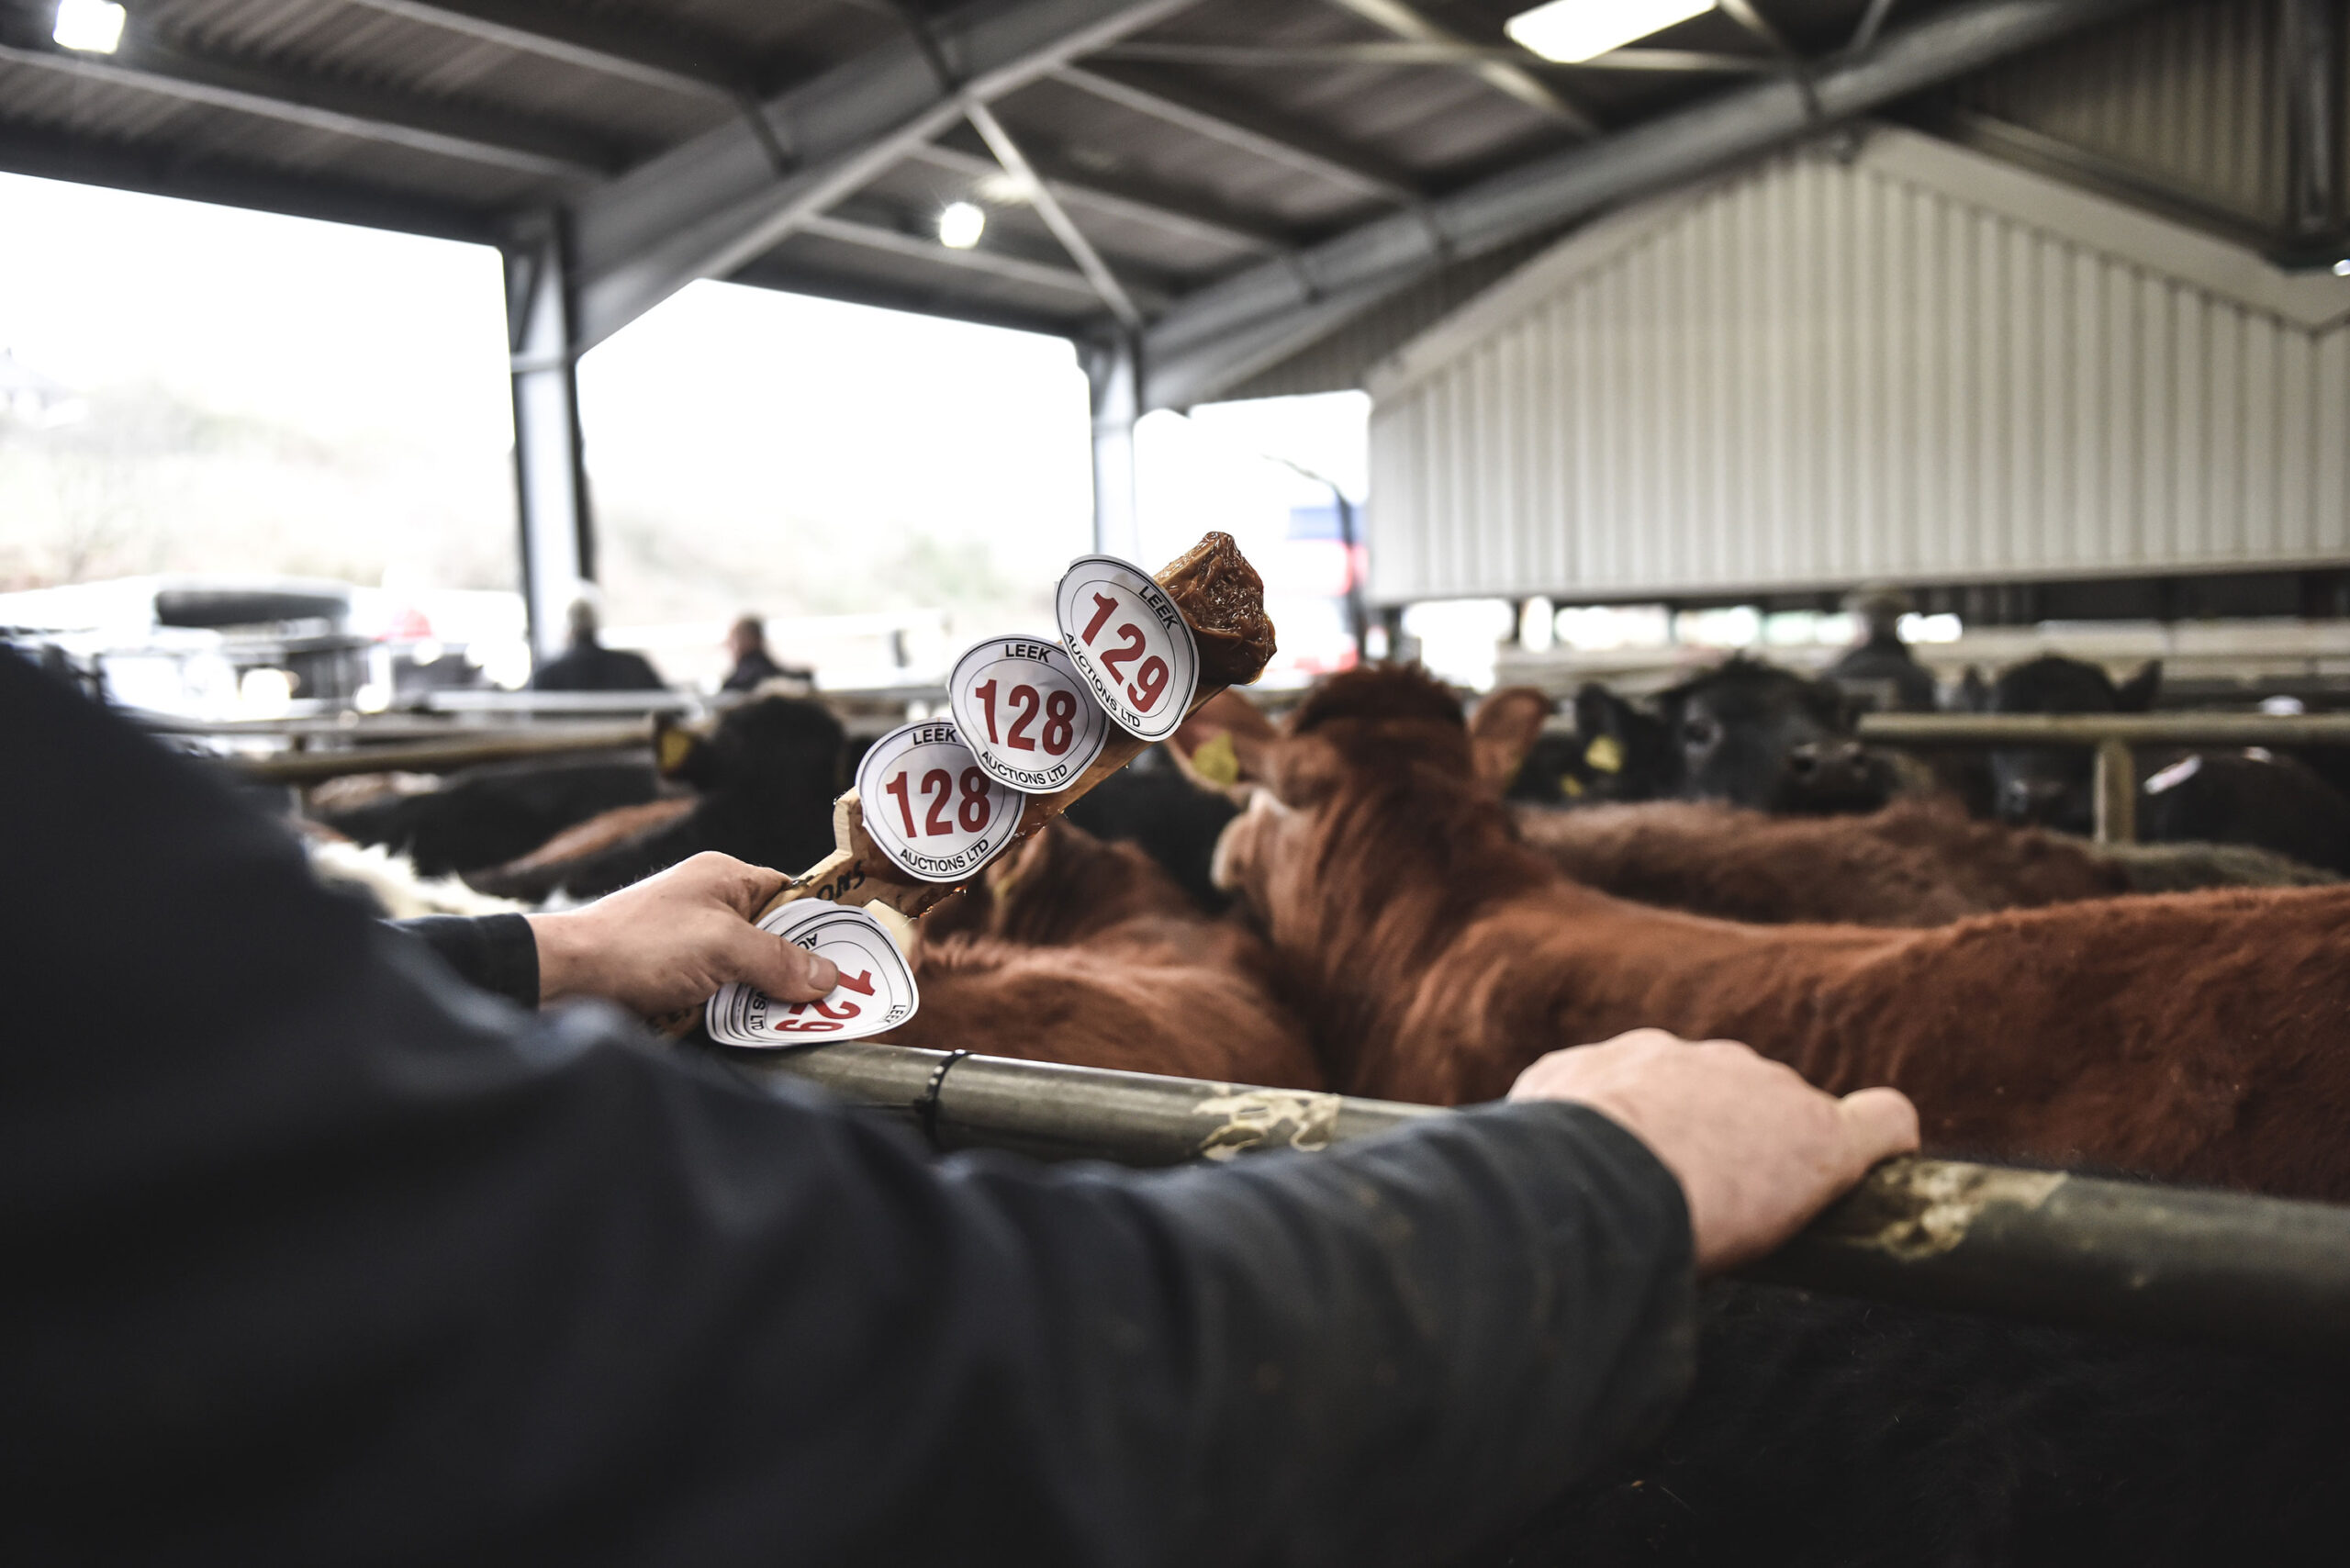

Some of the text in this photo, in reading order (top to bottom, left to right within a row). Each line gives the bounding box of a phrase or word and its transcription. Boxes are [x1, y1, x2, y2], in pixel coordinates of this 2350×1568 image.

[1138, 586, 1179, 631] LEEK
[1005, 644, 1051, 663] LEEK
[1081, 591, 1169, 713] 129
[1066, 633, 1141, 728] AUCTIONS LTD
[912, 728, 957, 745] LEEK
[975, 678, 1077, 756] 128
[981, 751, 1068, 785] AUCTIONS LTD
[886, 767, 990, 838] 128
[900, 839, 990, 871] AUCTIONS LTD
[750, 1014, 765, 1031] LTD
[775, 969, 876, 1032] 129
